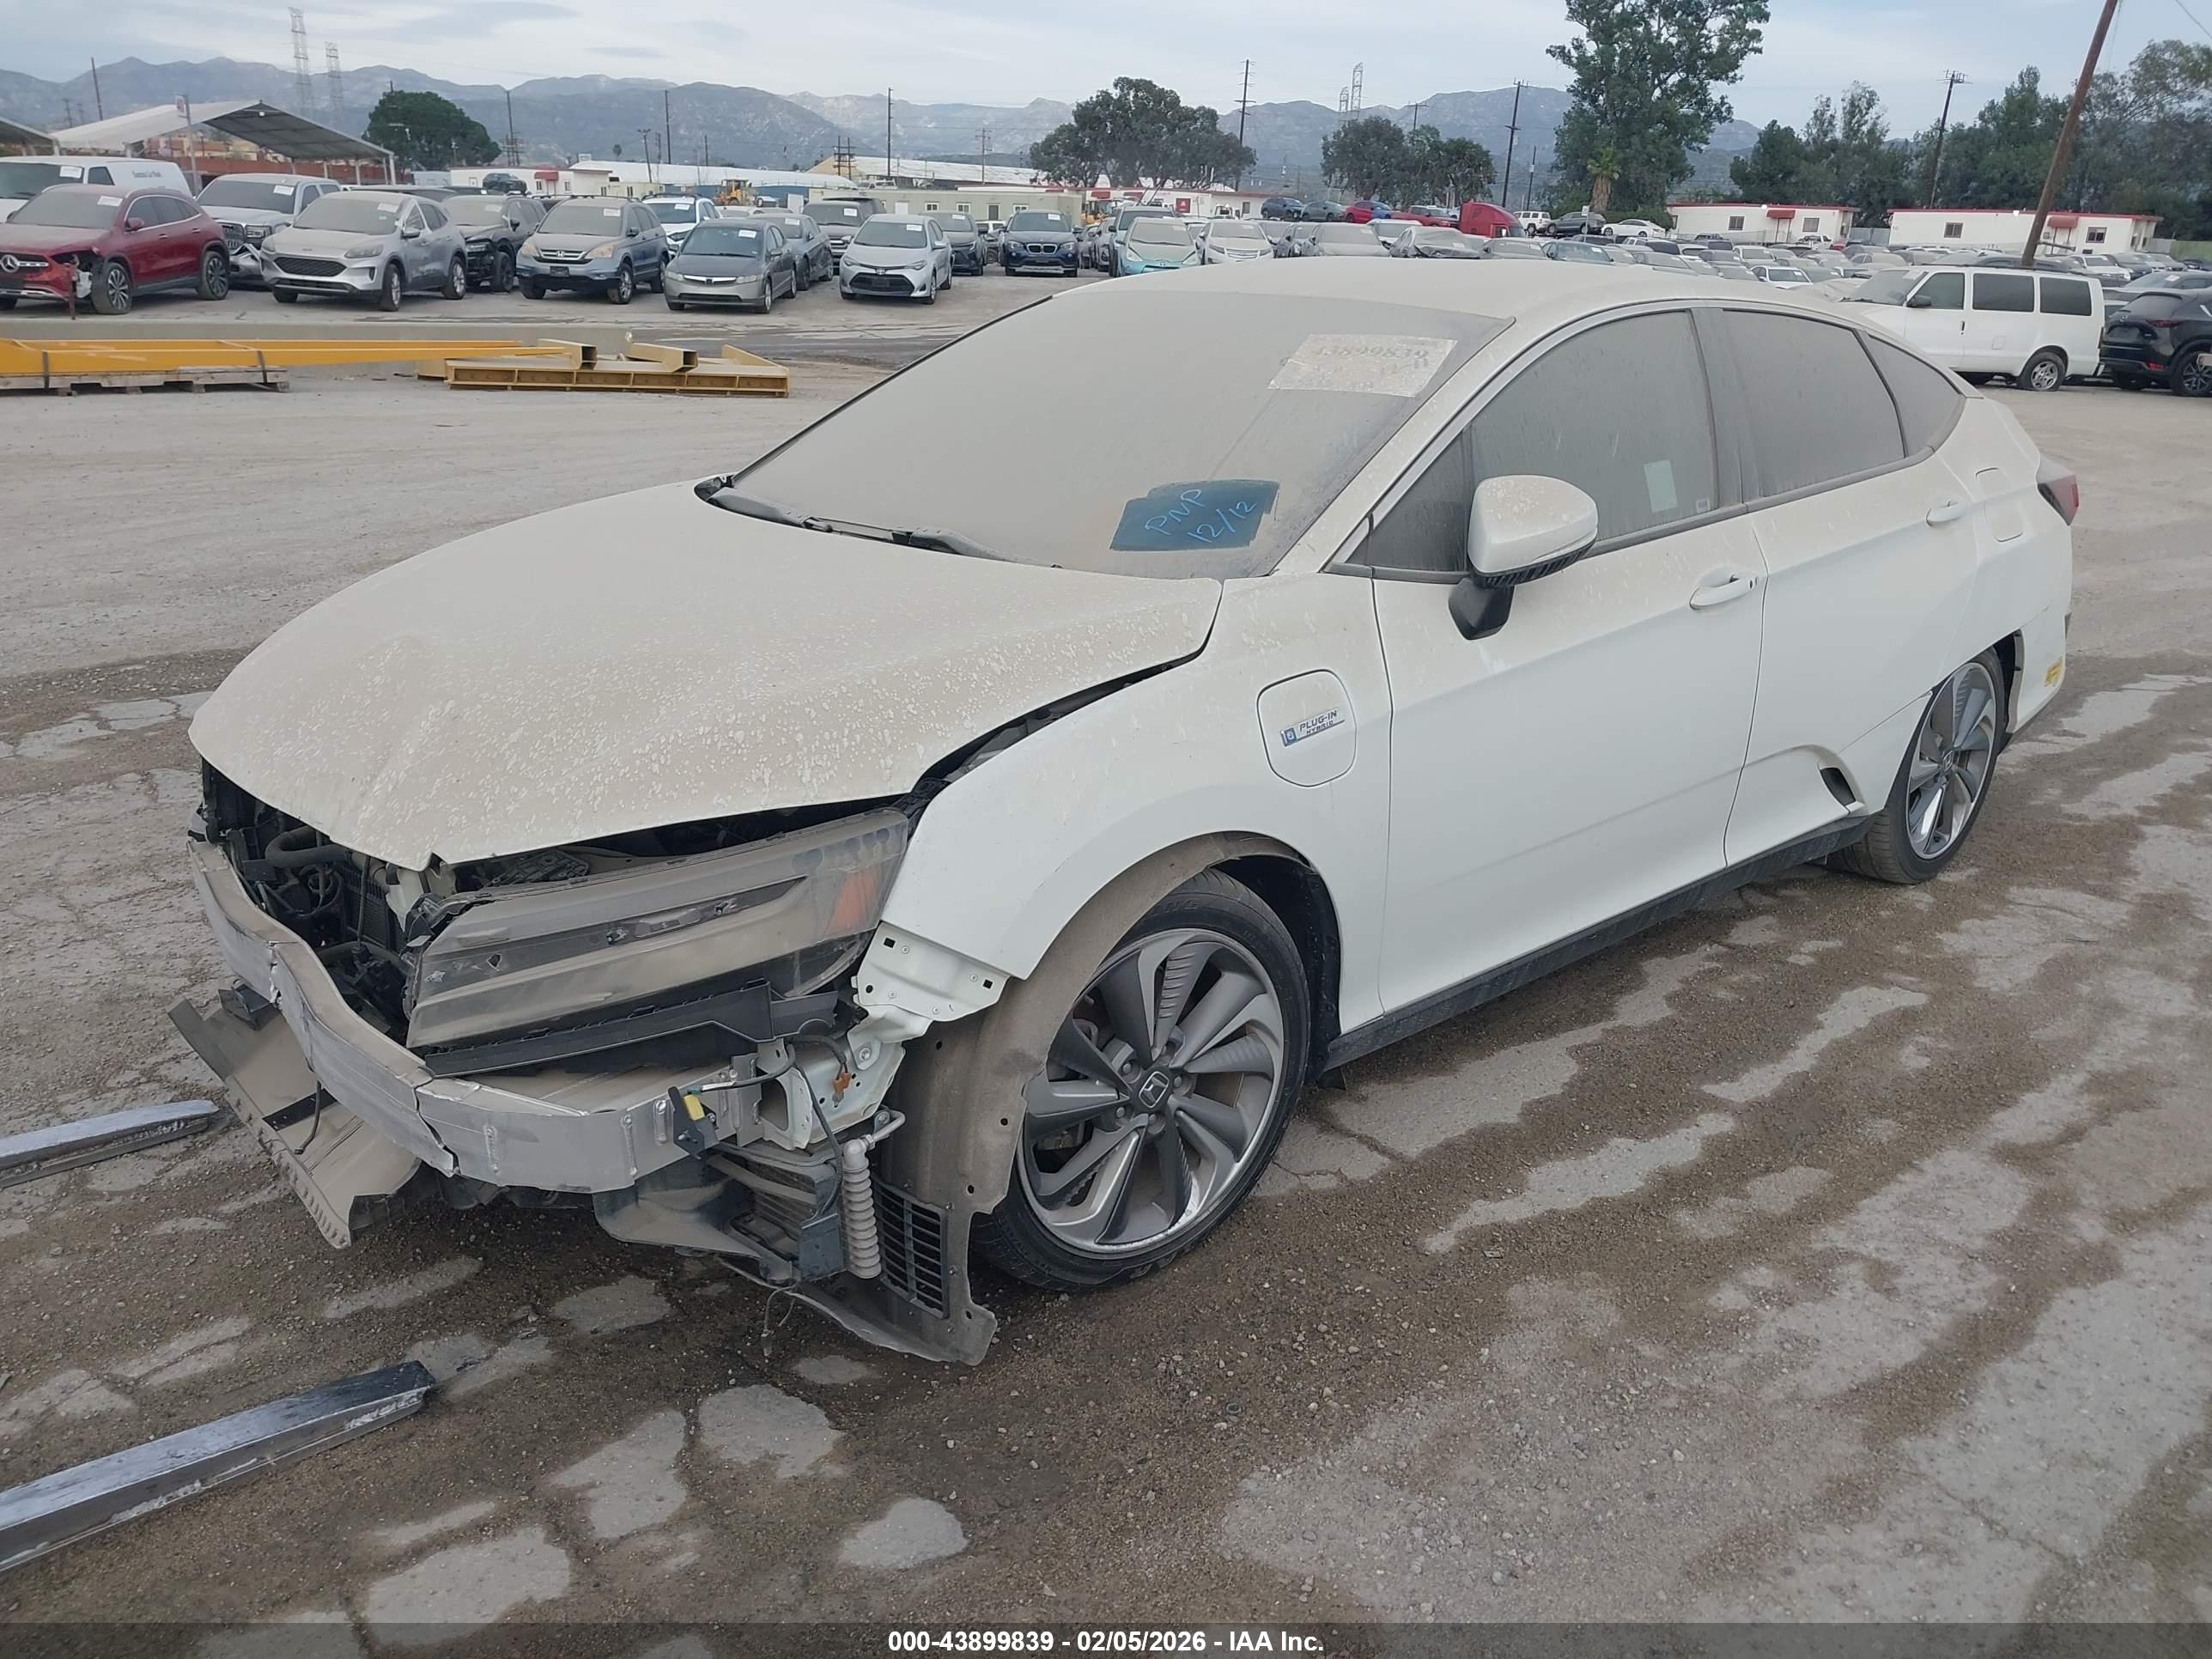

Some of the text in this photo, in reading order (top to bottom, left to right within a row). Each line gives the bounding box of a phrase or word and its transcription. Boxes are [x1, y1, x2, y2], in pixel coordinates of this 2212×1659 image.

[1144, 489, 1206, 536] PNP
[1187, 501, 1257, 544] 12/12
[1299, 709, 1337, 732] PLUG-IN
[1306, 720, 1334, 735] HYBRID
